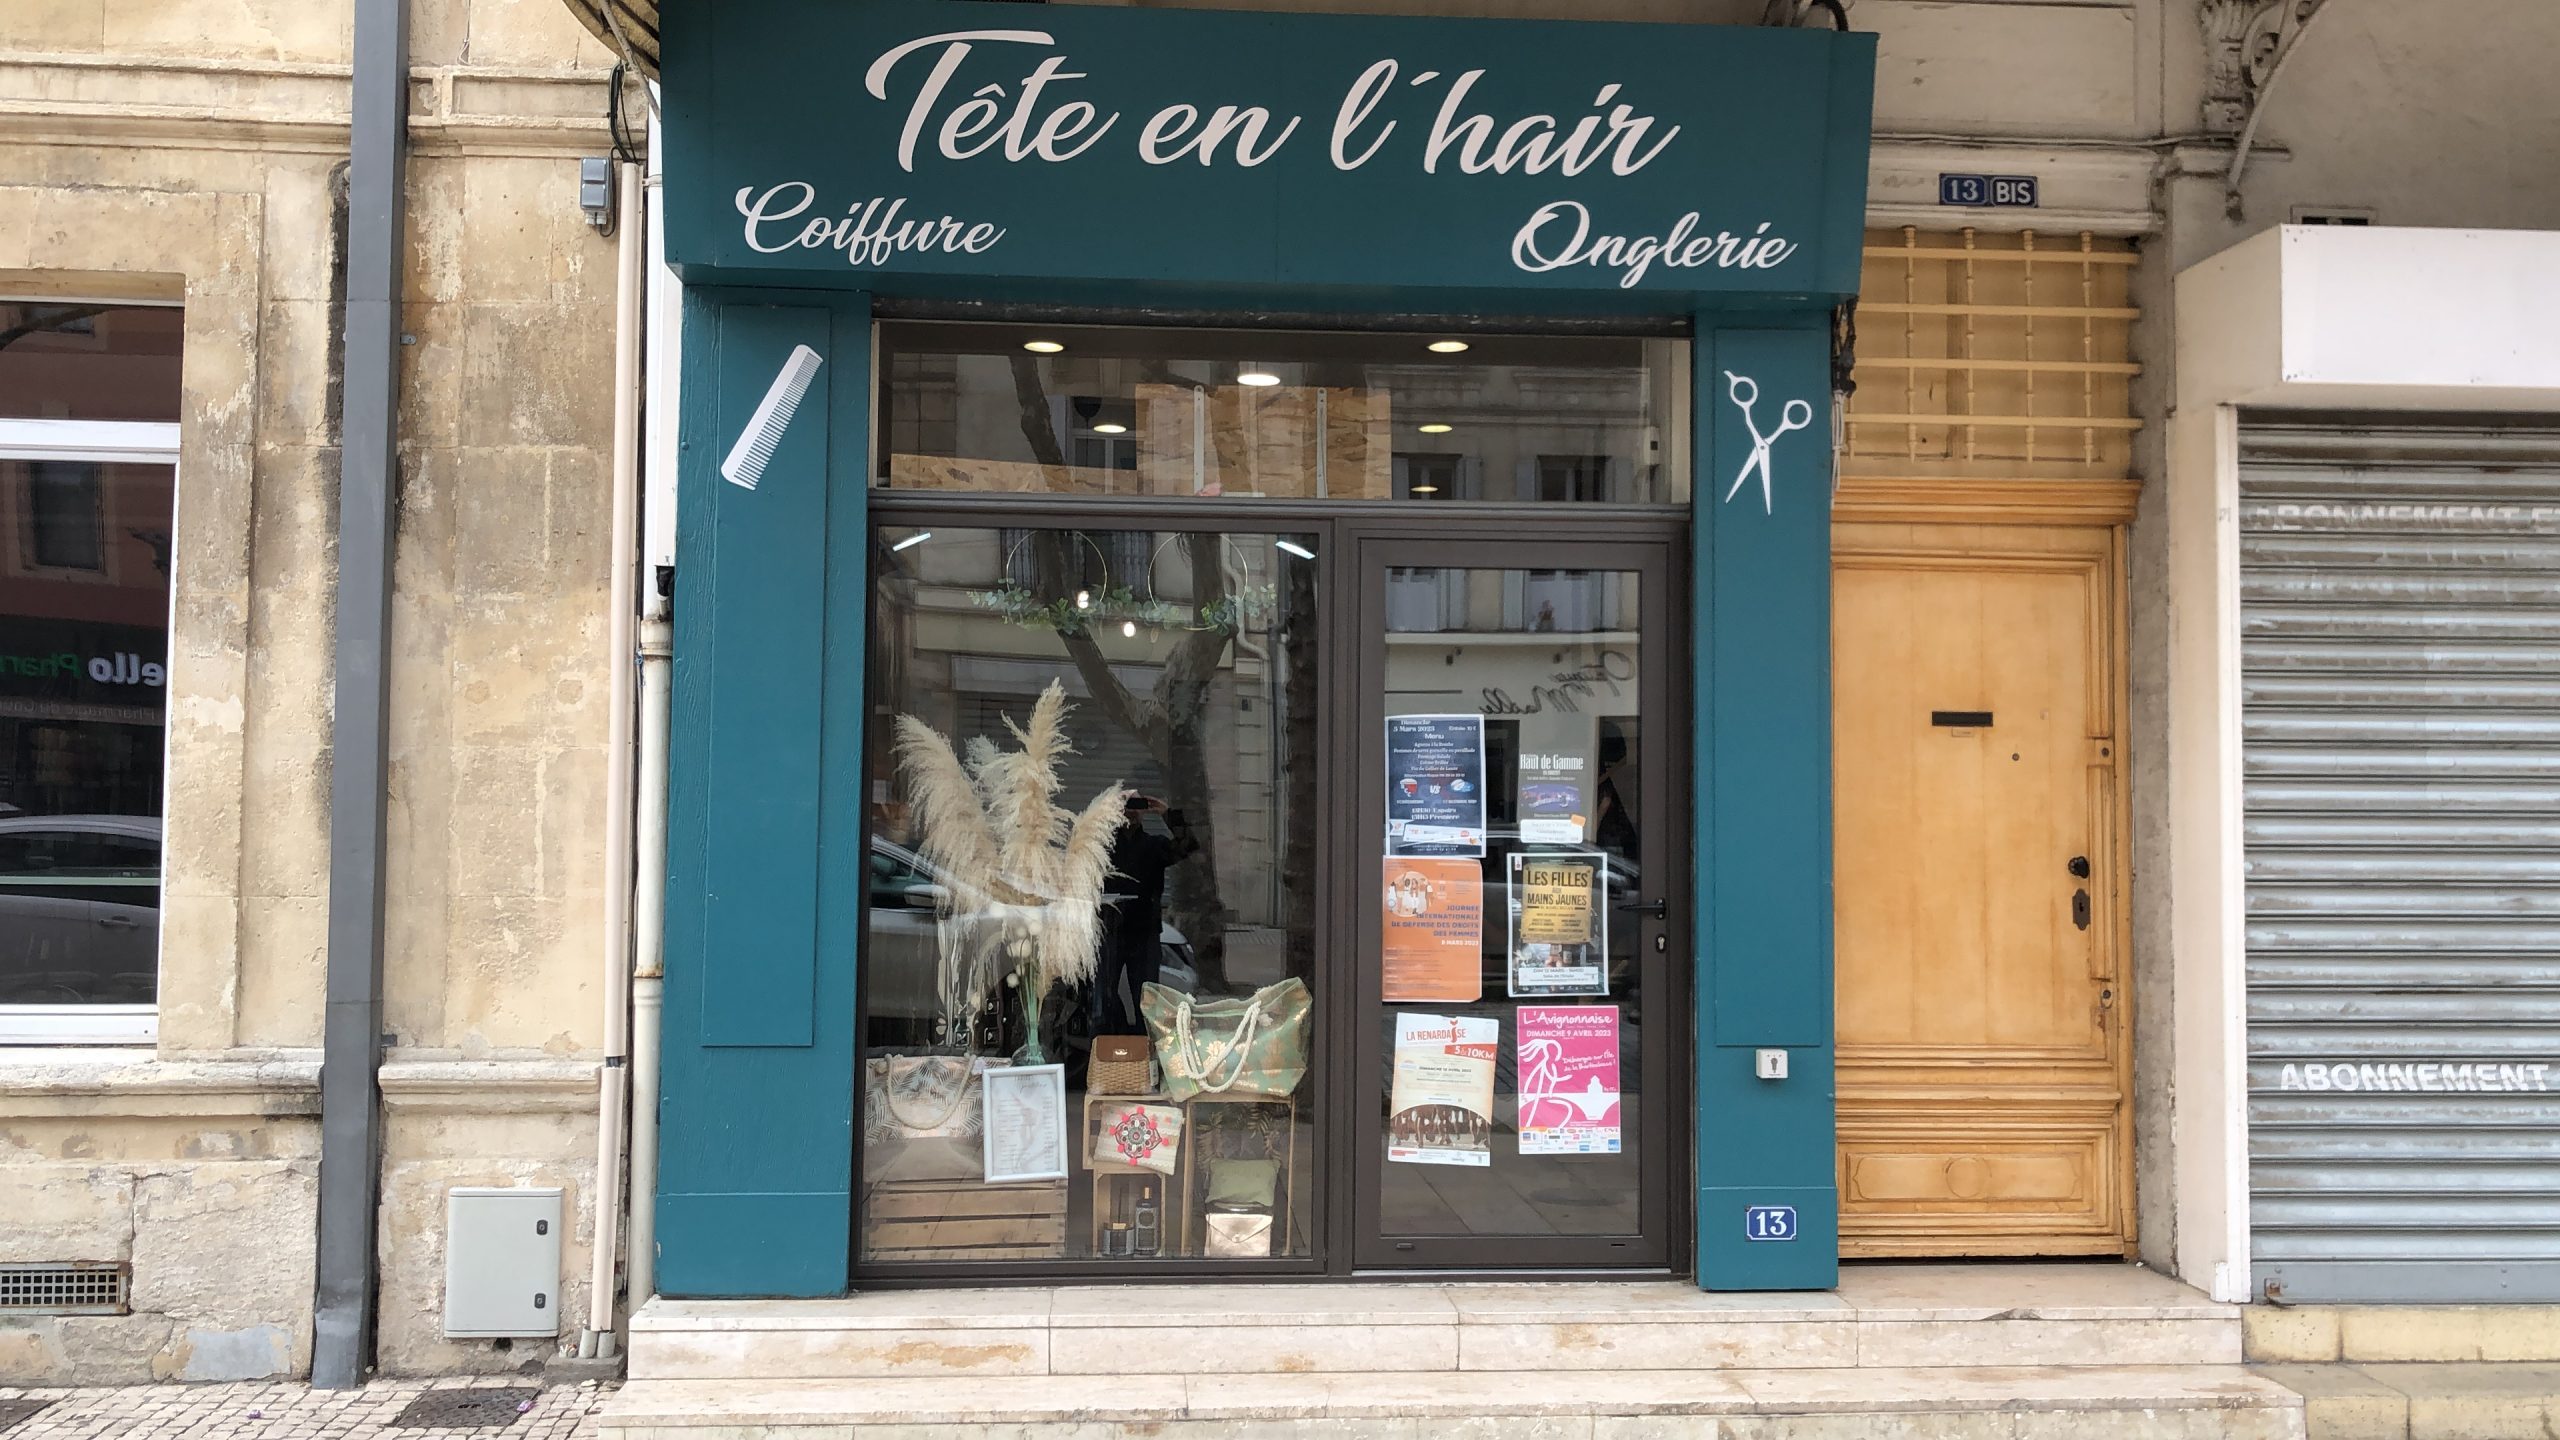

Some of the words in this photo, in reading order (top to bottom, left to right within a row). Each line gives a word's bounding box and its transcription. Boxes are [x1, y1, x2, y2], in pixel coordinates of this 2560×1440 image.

[865, 30, 1119, 172] Tête
[1138, 103, 1302, 167] en
[1951, 179, 1979, 201] 13
[1996, 181, 2032, 204] BIS
[735, 181, 1007, 267] Coiffure
[1512, 200, 1798, 289] Onglerie
[1520, 754, 1539, 770] Haut
[1541, 754, 1551, 770] de
[1553, 754, 1584, 770] Gamme
[1527, 870, 1548, 886] LES
[1551, 871, 1588, 887] FILLES
[1527, 893, 1554, 905] MAINS
[1555, 894, 1587, 906] JAUNES
[1416, 912, 1479, 920] INTERNATIONALE
[1523, 1011, 1613, 1029] L'Avignonnaise
[1406, 1031, 1416, 1041] LA
[1417, 1027, 1468, 1043] RENARDAISE
[1573, 1029, 1593, 1037] AVRIL
[1454, 1045, 1460, 1054] 5
[1467, 1047, 1495, 1060] 10KM
[2280, 1063, 2549, 1091] ABONNEMENT
[1756, 1211, 1788, 1236] 13
